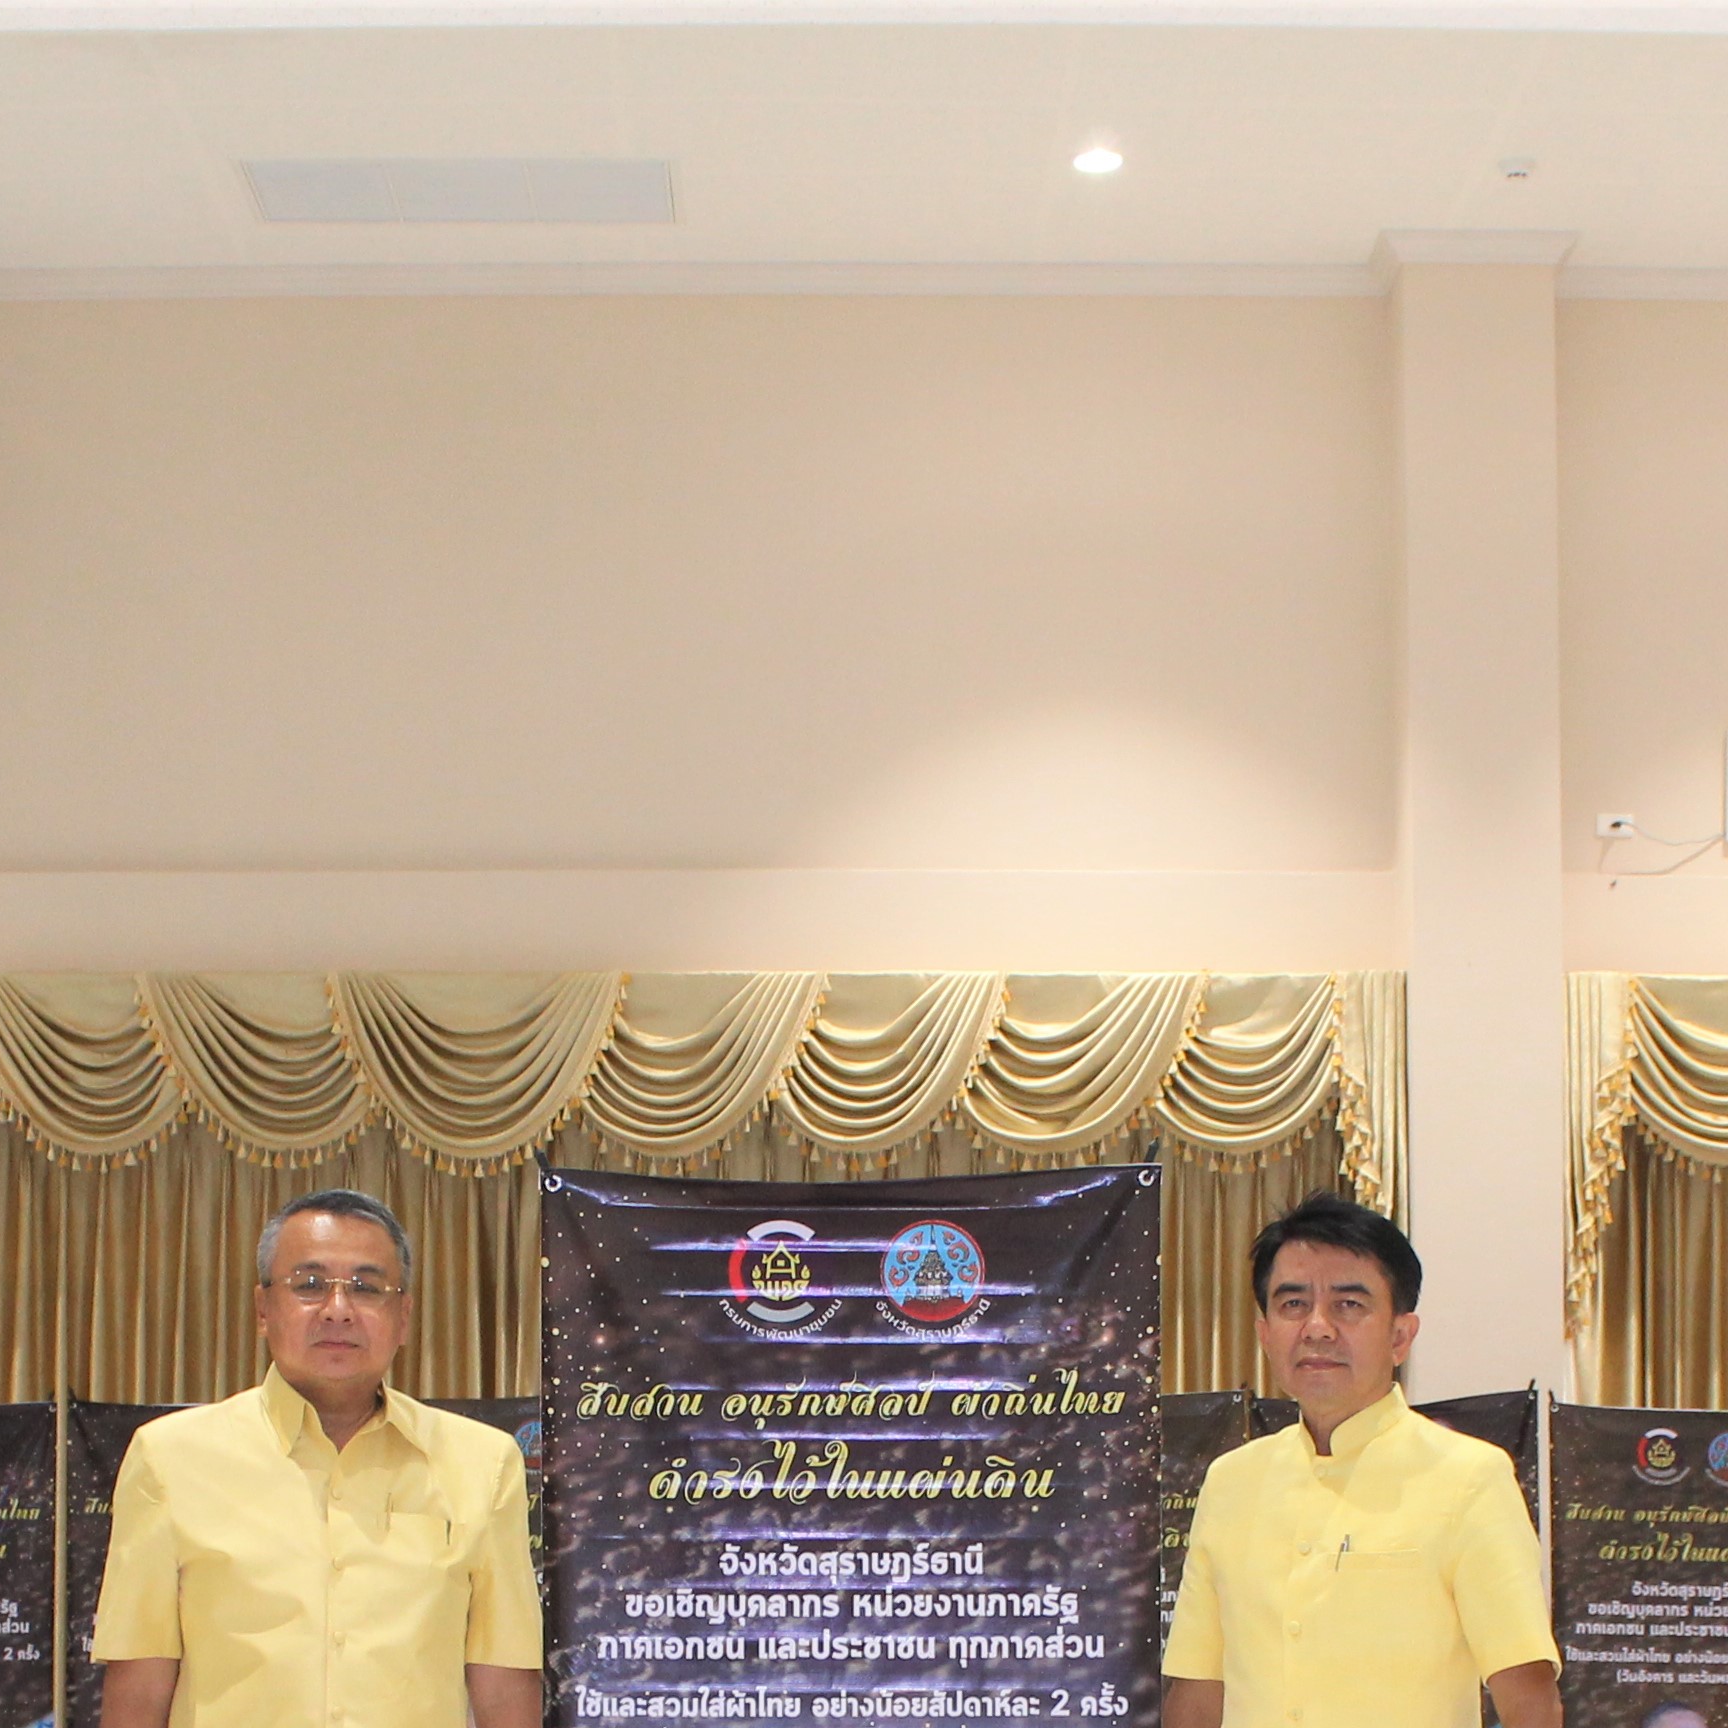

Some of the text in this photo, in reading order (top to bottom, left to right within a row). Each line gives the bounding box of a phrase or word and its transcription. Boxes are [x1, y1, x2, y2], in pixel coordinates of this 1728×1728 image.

[719, 1298, 842, 1341] กรมการพัฒนาชุมชน
[720, 1543, 983, 1586] จังหวัดสุราษฎร์ธานี
[625, 1584, 1079, 1627] ขอเชิญบุคลากร หน่วยงานภาครัฐ
[3, 1648, 13, 1661] 2
[597, 1626, 1104, 1668] ภาคเอกชน และประชาชน ทุกภาคส่วน
[575, 1682, 1129, 1717] ใช้และสวมใส่ผ้าไทย อย่างน้อยสัปดาห์ละ 2 ครั้ง
